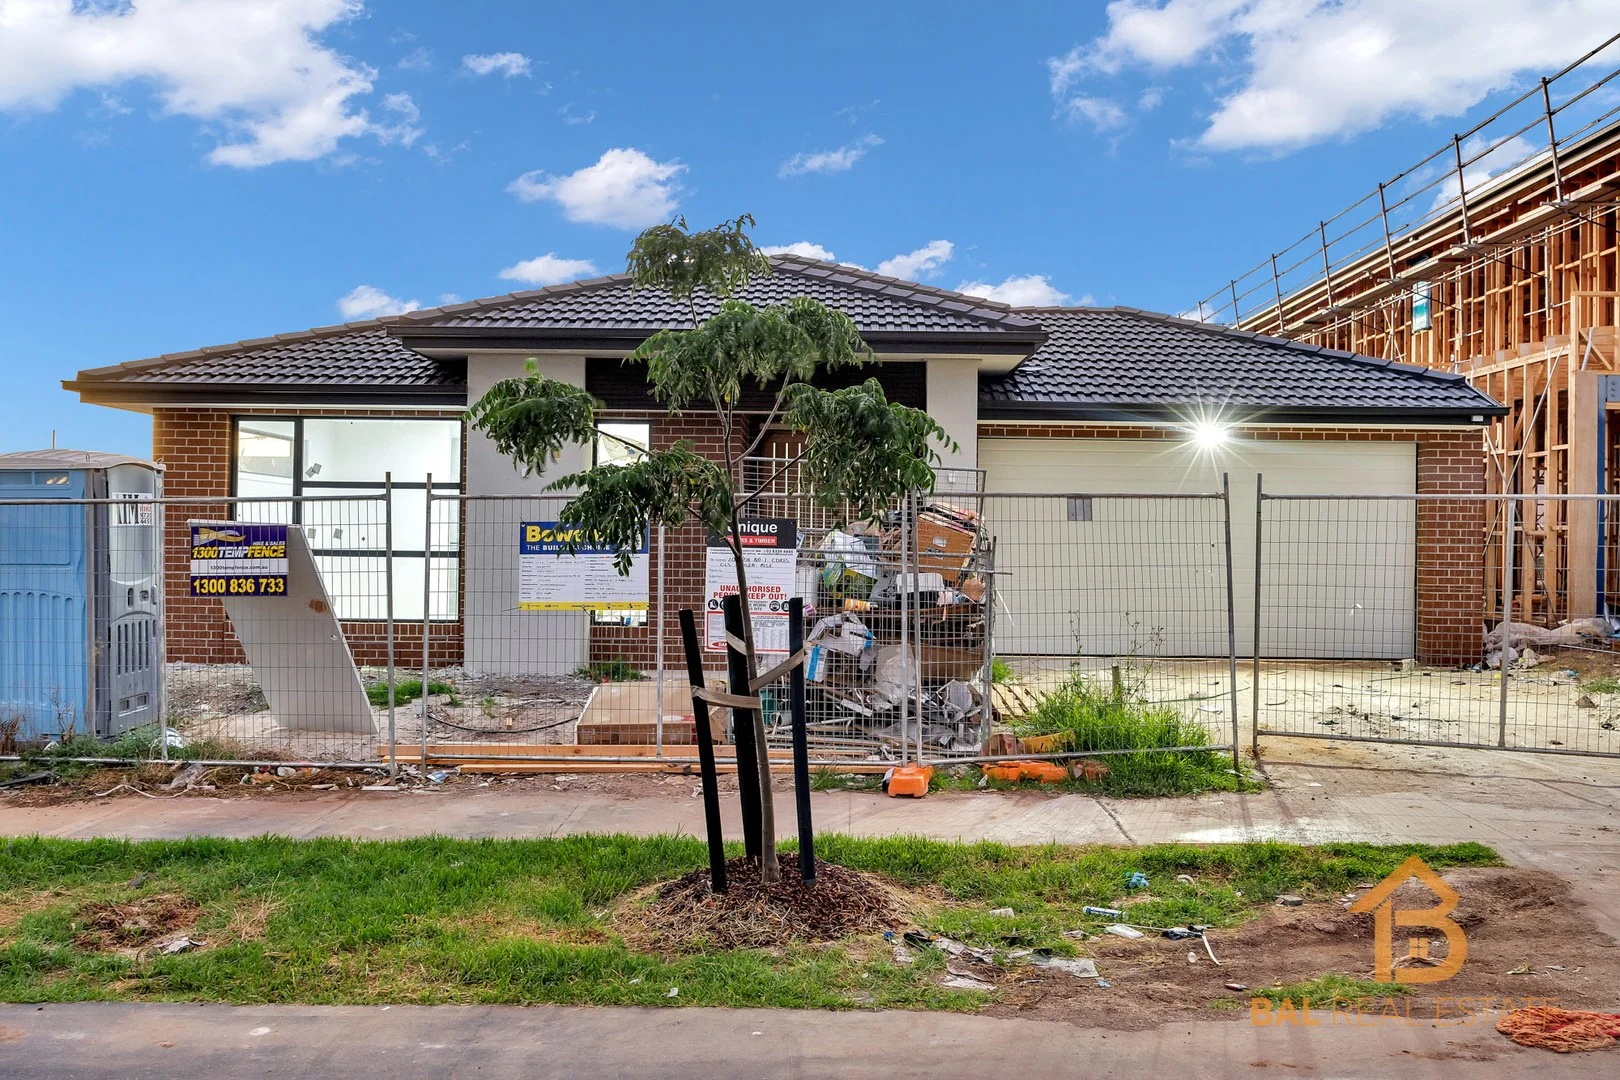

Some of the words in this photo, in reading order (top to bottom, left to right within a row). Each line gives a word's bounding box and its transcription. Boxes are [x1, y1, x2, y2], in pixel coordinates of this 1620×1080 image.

[526, 525, 609, 542] Bowe
[192, 545, 286, 559] 1300TEMPFENCE
[193, 578, 226, 594] 1300
[229, 578, 255, 593] 836
[258, 577, 285, 593] 733
[720, 585, 781, 593] UNAUHORISED
